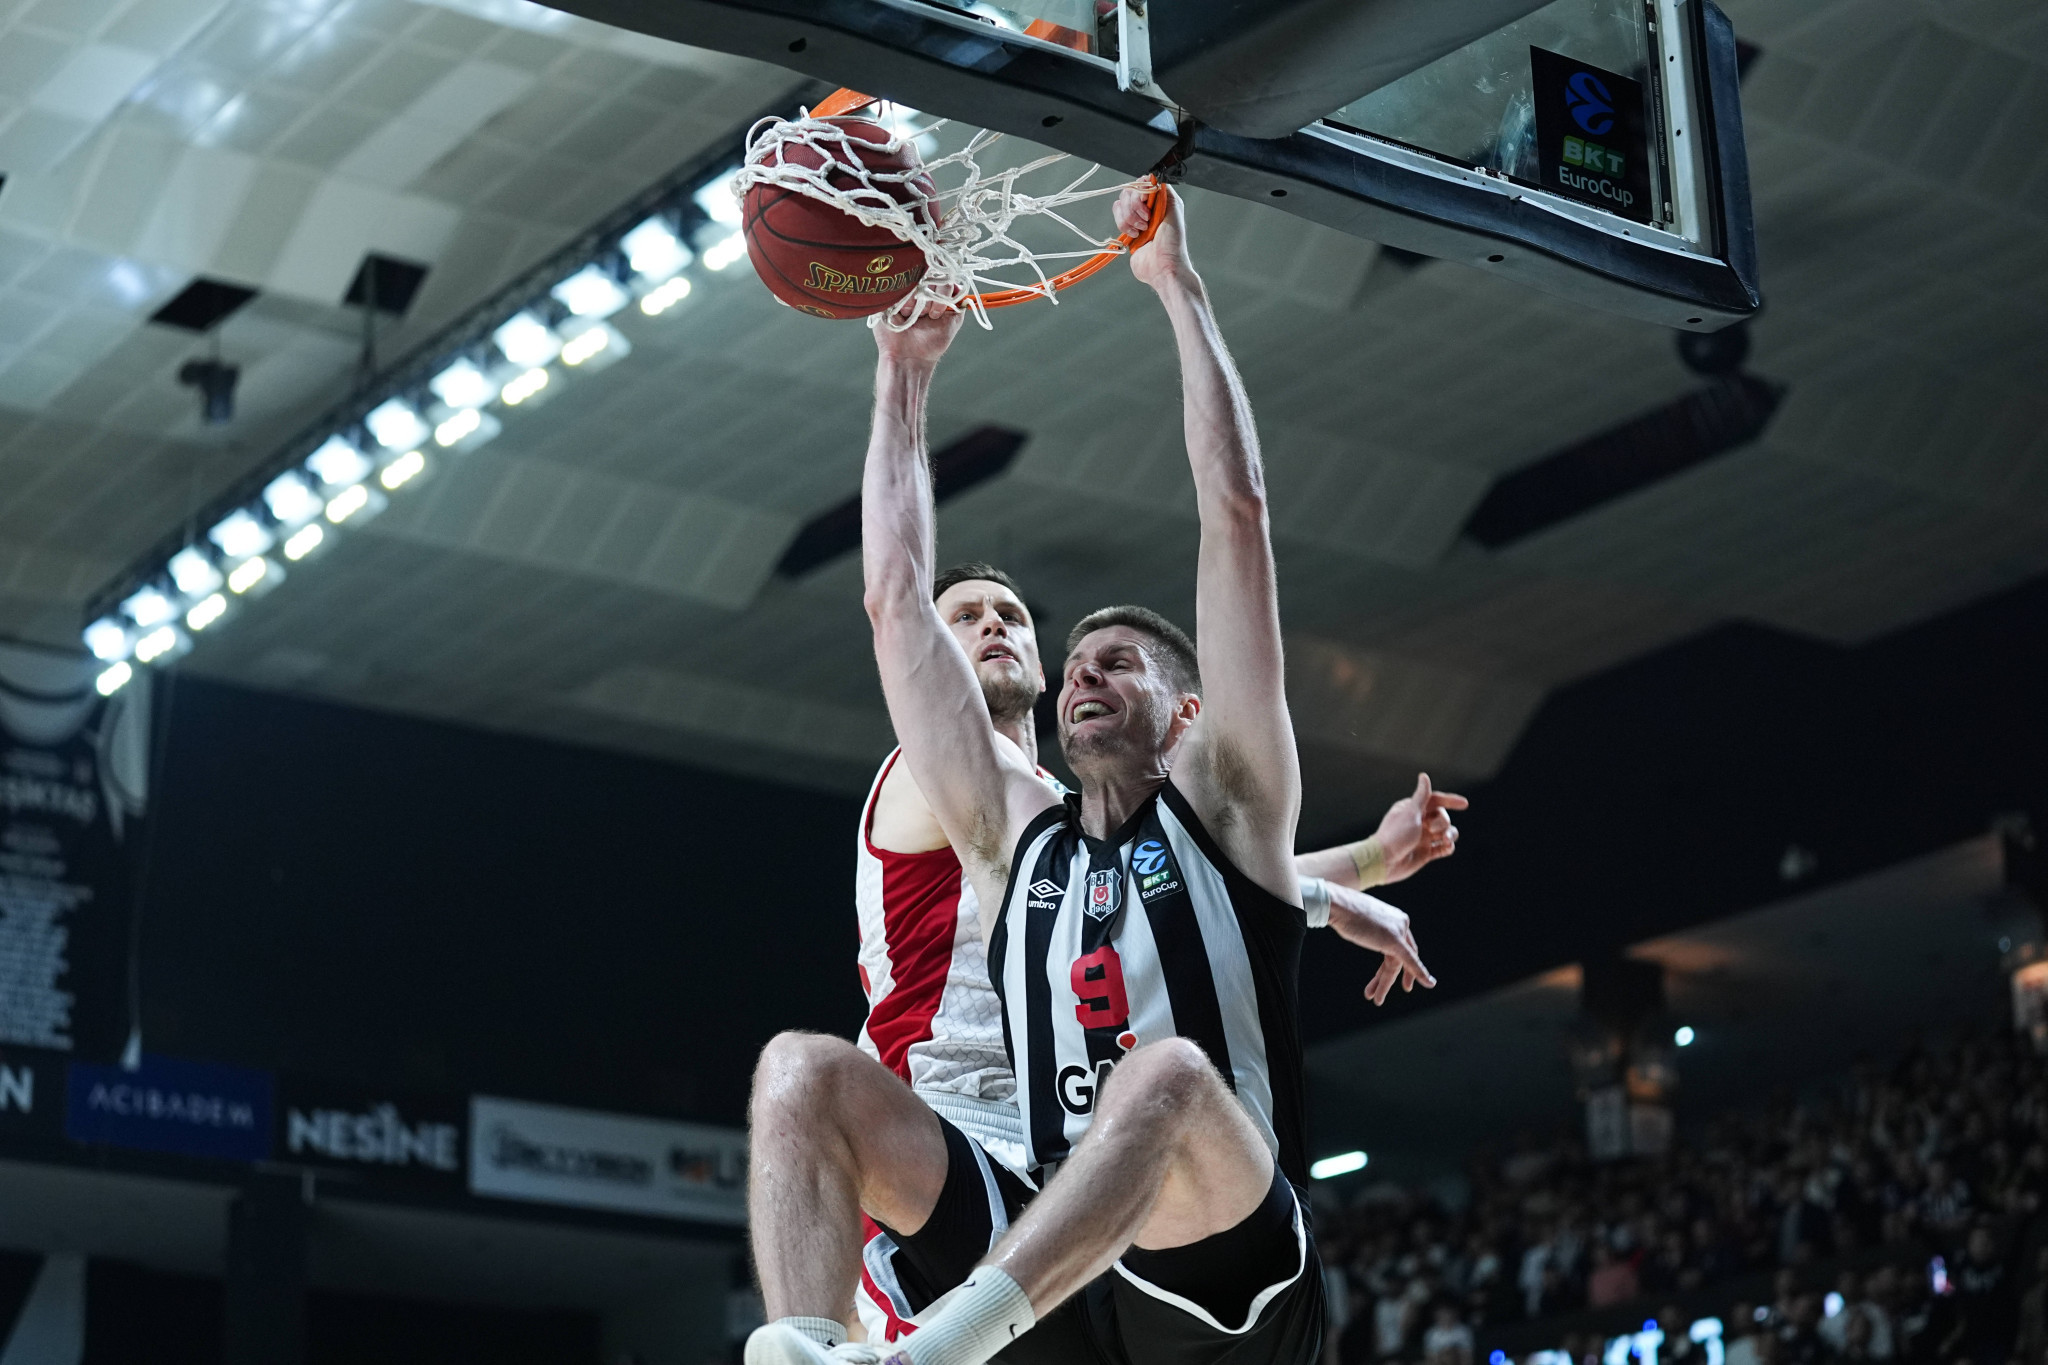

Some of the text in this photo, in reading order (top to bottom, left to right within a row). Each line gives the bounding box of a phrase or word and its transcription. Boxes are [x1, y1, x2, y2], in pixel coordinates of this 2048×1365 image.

[1564, 139, 1624, 173] BKT
[1558, 165, 1634, 208] EuroCup
[804, 261, 920, 294] SPALDIN
[1090, 873, 1113, 887] BJK
[1143, 870, 1168, 889] BKT
[1141, 880, 1178, 899] EuroCup
[1028, 899, 1056, 910] umbro
[1091, 904, 1112, 914] 1903
[1070, 945, 1130, 1030] 9
